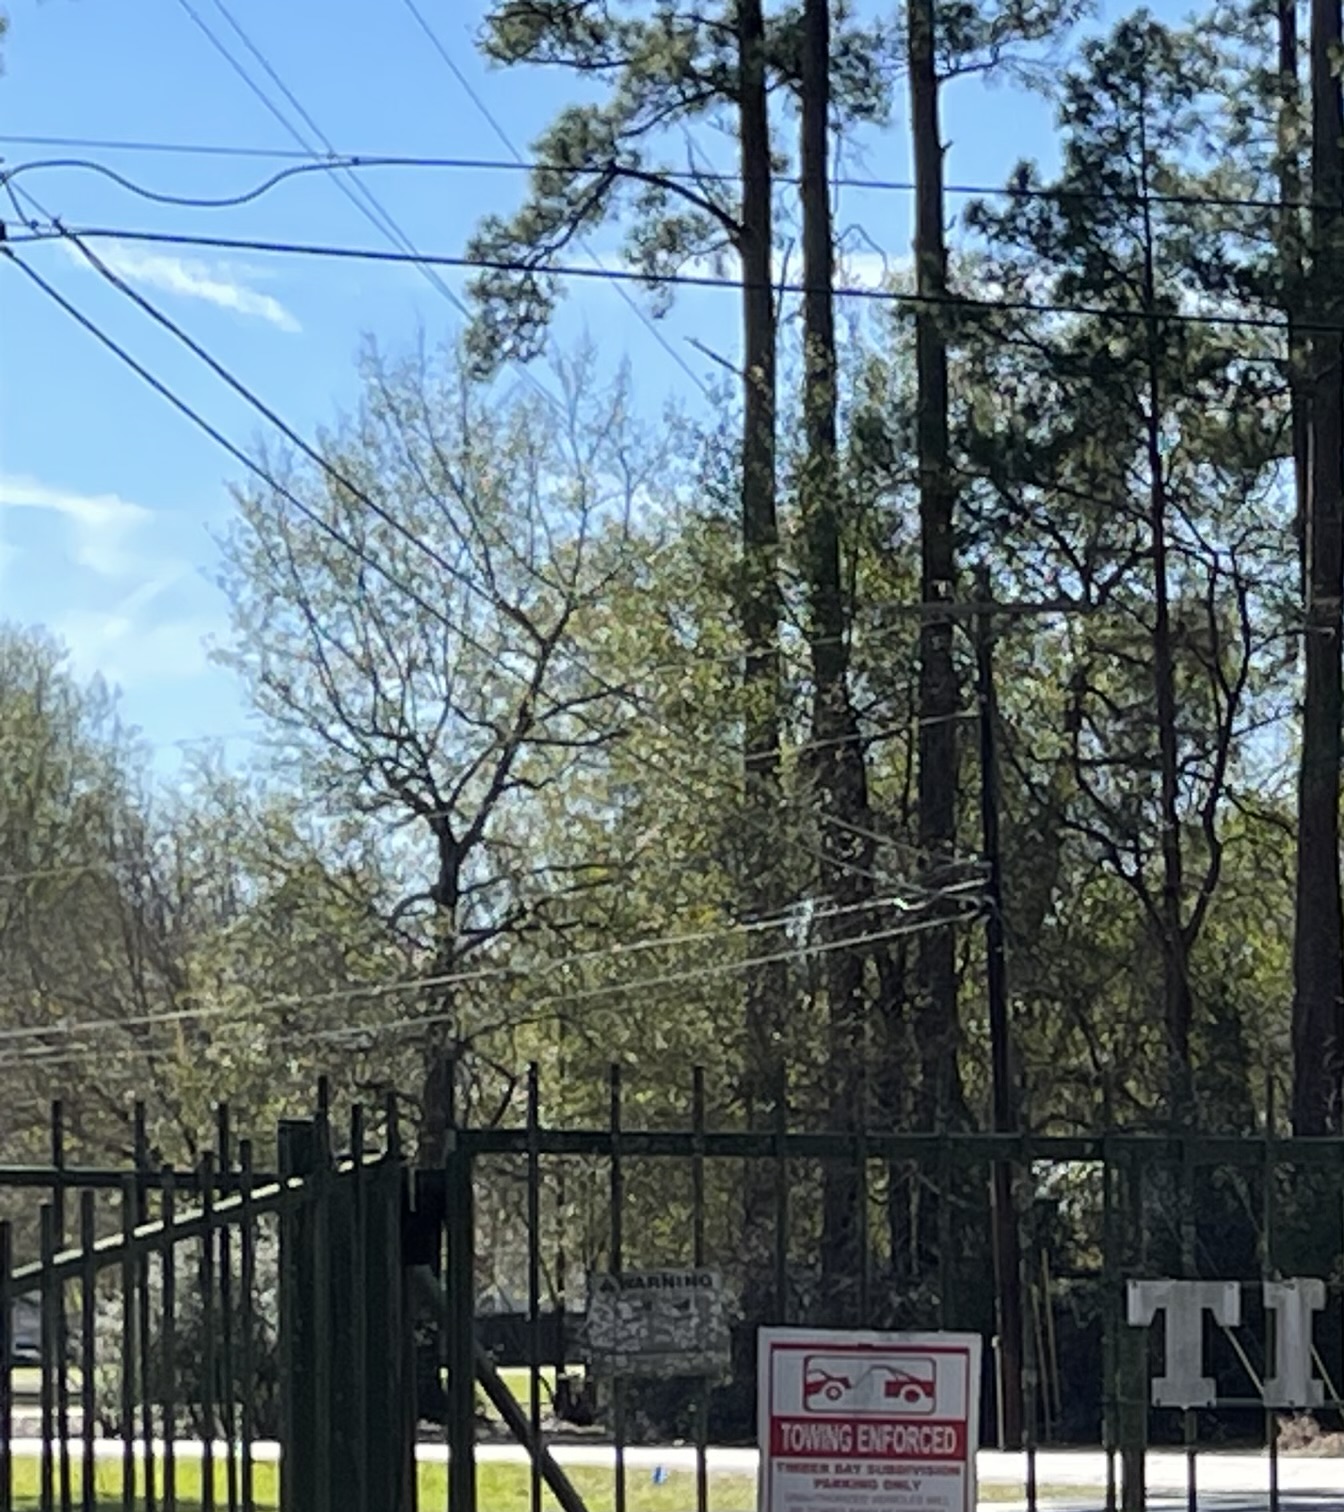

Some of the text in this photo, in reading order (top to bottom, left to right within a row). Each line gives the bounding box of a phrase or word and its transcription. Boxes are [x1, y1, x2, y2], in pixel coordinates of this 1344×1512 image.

[781, 1423, 956, 1454] TOWING ENFORCED
[777, 1462, 960, 1476] TIMBER BAY SUBDIVISION
[813, 1478, 922, 1491] PARKING ONLY
